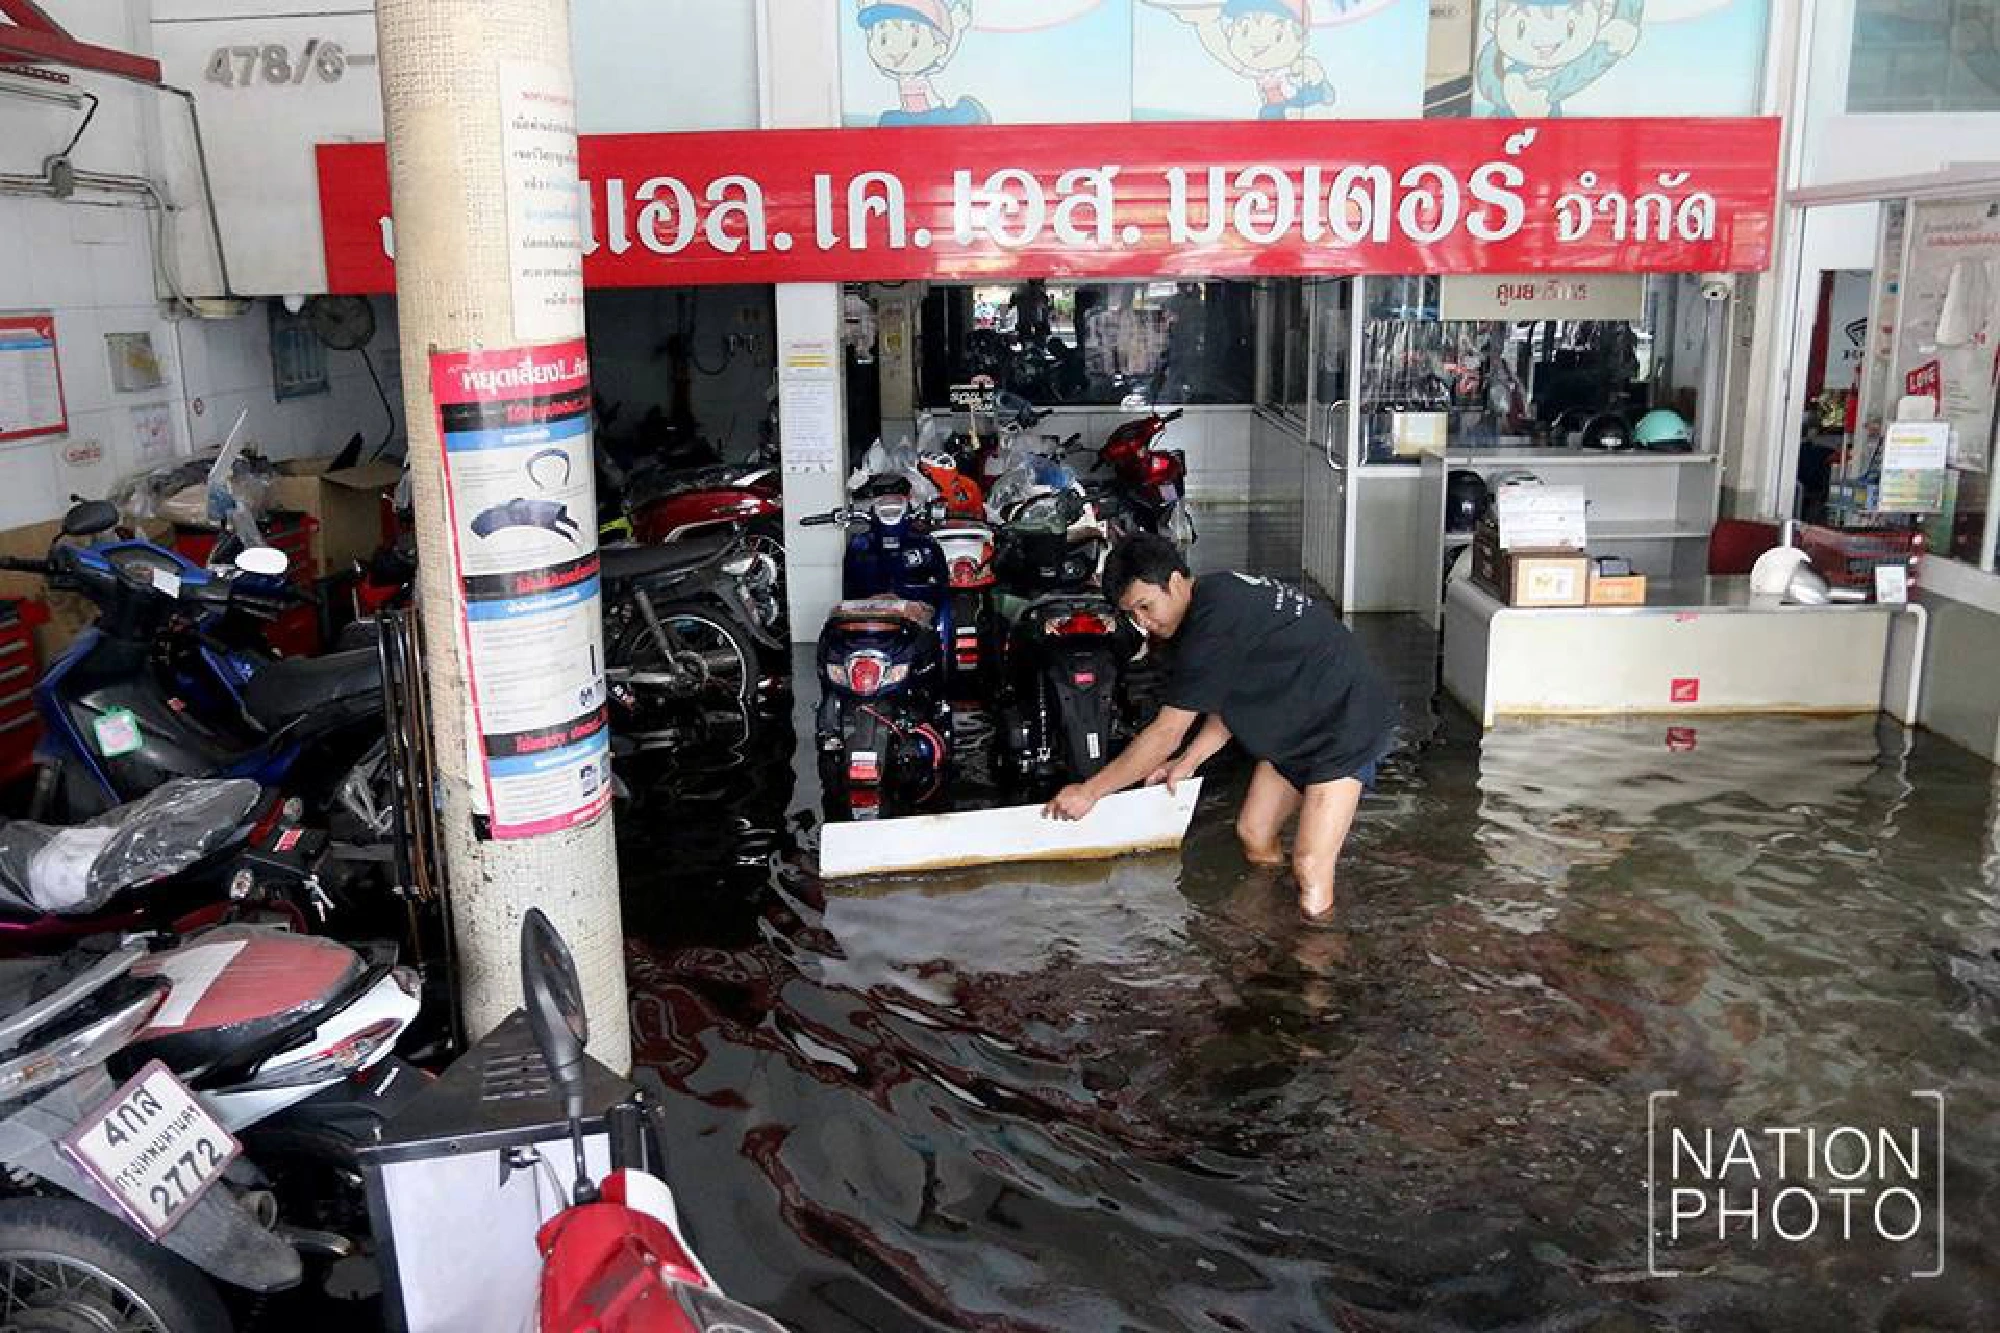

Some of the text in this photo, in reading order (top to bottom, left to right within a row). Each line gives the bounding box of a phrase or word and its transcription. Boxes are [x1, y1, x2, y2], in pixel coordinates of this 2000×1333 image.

[814, 172, 932, 251] เค.
[953, 166, 1142, 250] เอส.
[1166, 127, 1538, 245] มอเตอร์
[1554, 171, 1716, 243] จำกัด
[149, 1138, 224, 1217] 2772
